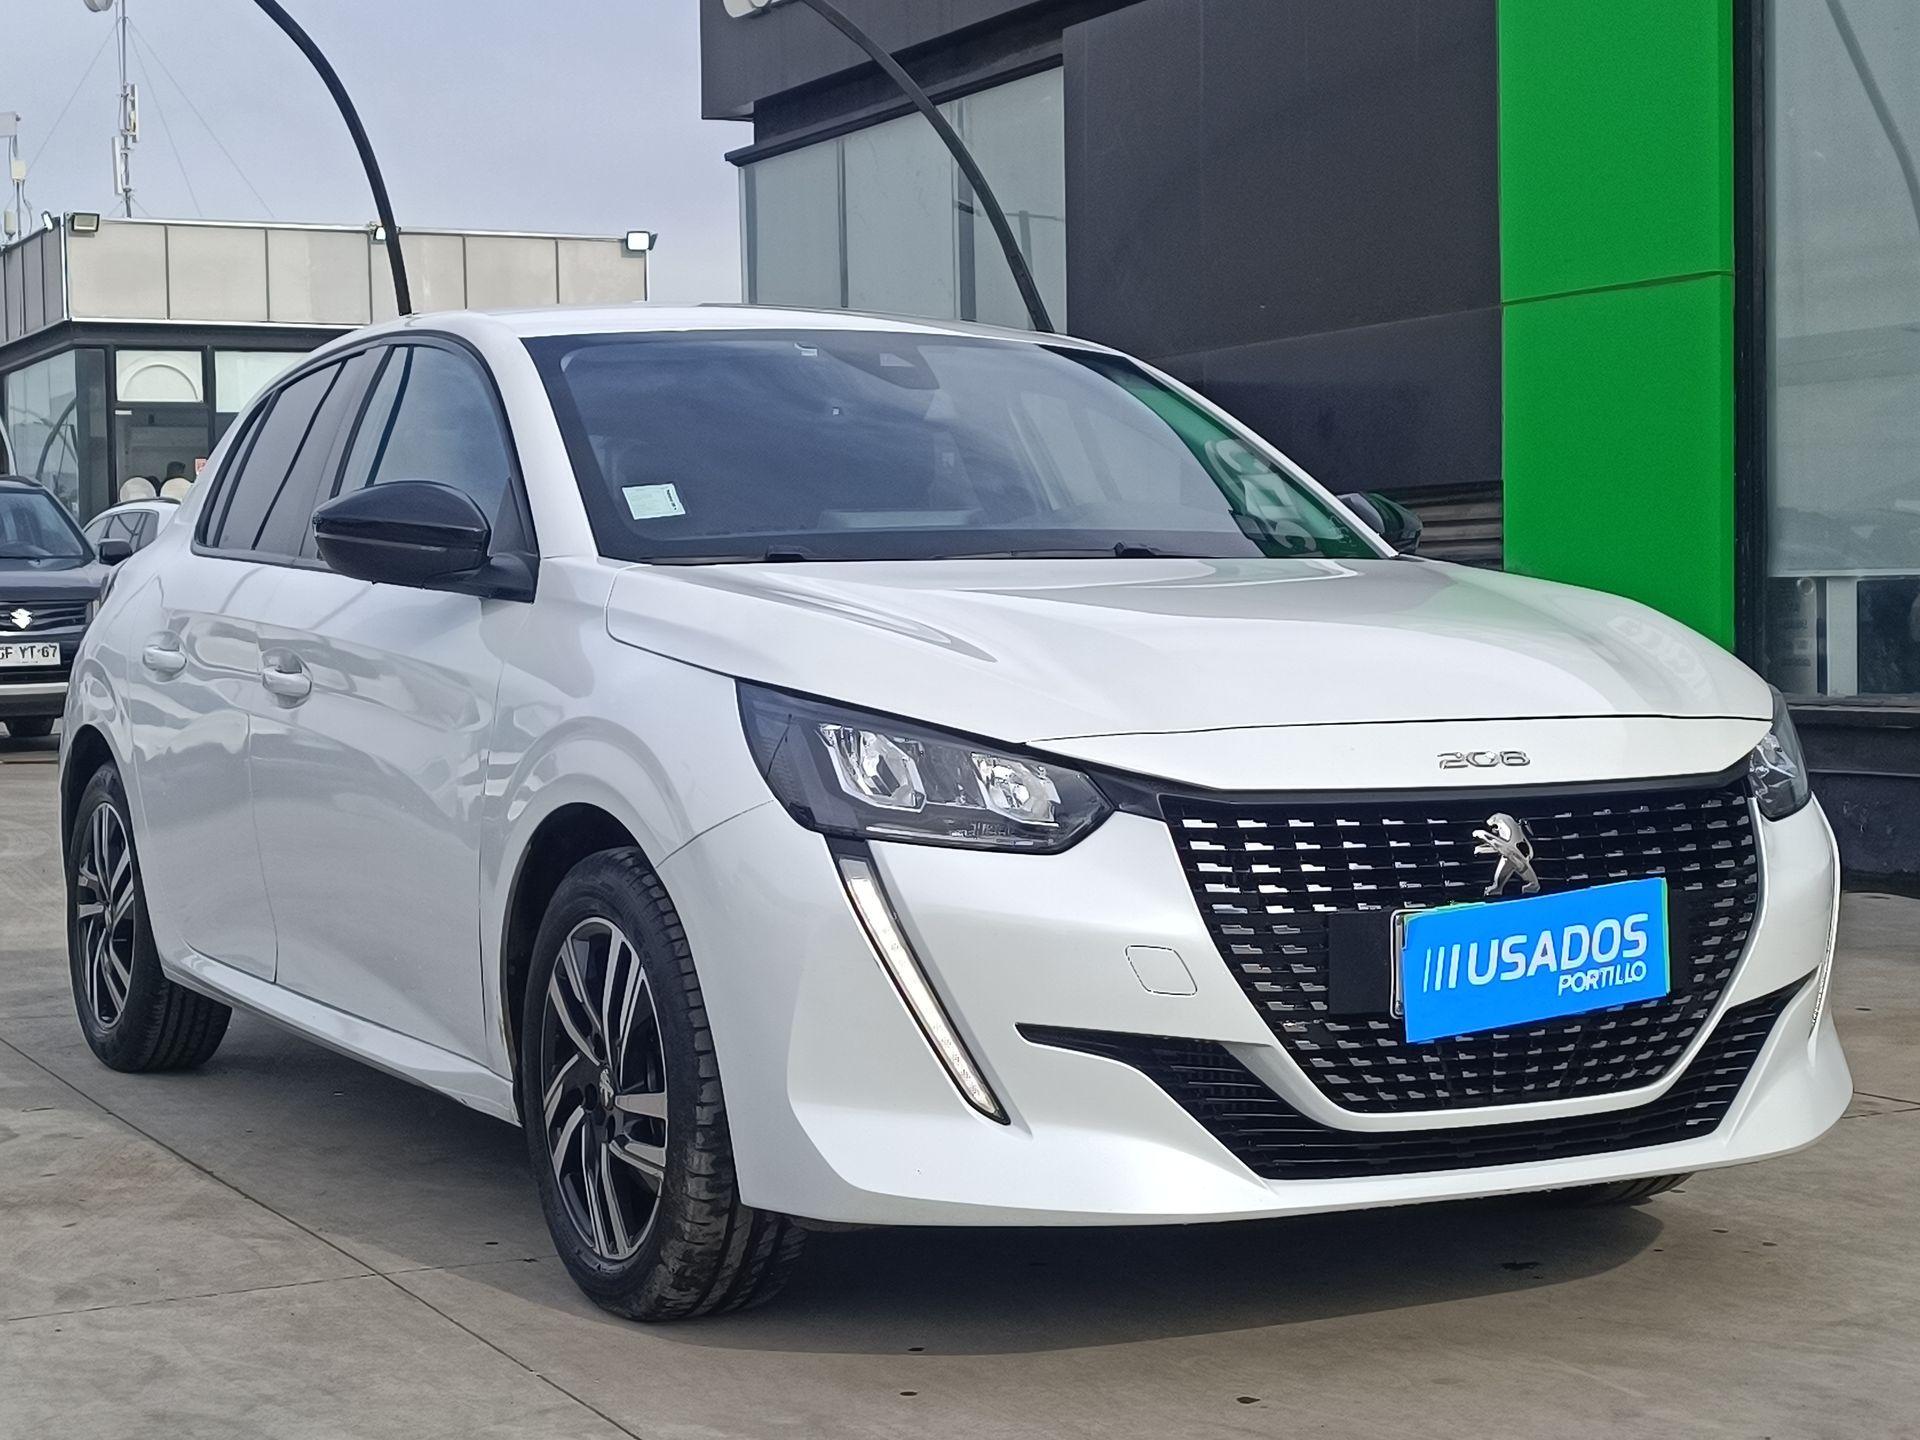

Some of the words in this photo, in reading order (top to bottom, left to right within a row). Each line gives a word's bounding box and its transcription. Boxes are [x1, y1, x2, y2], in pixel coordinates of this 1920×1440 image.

[1437, 751, 1531, 769] 208
[1467, 913, 1649, 986] USADOS
[1558, 960, 1647, 996] PORTILLO
